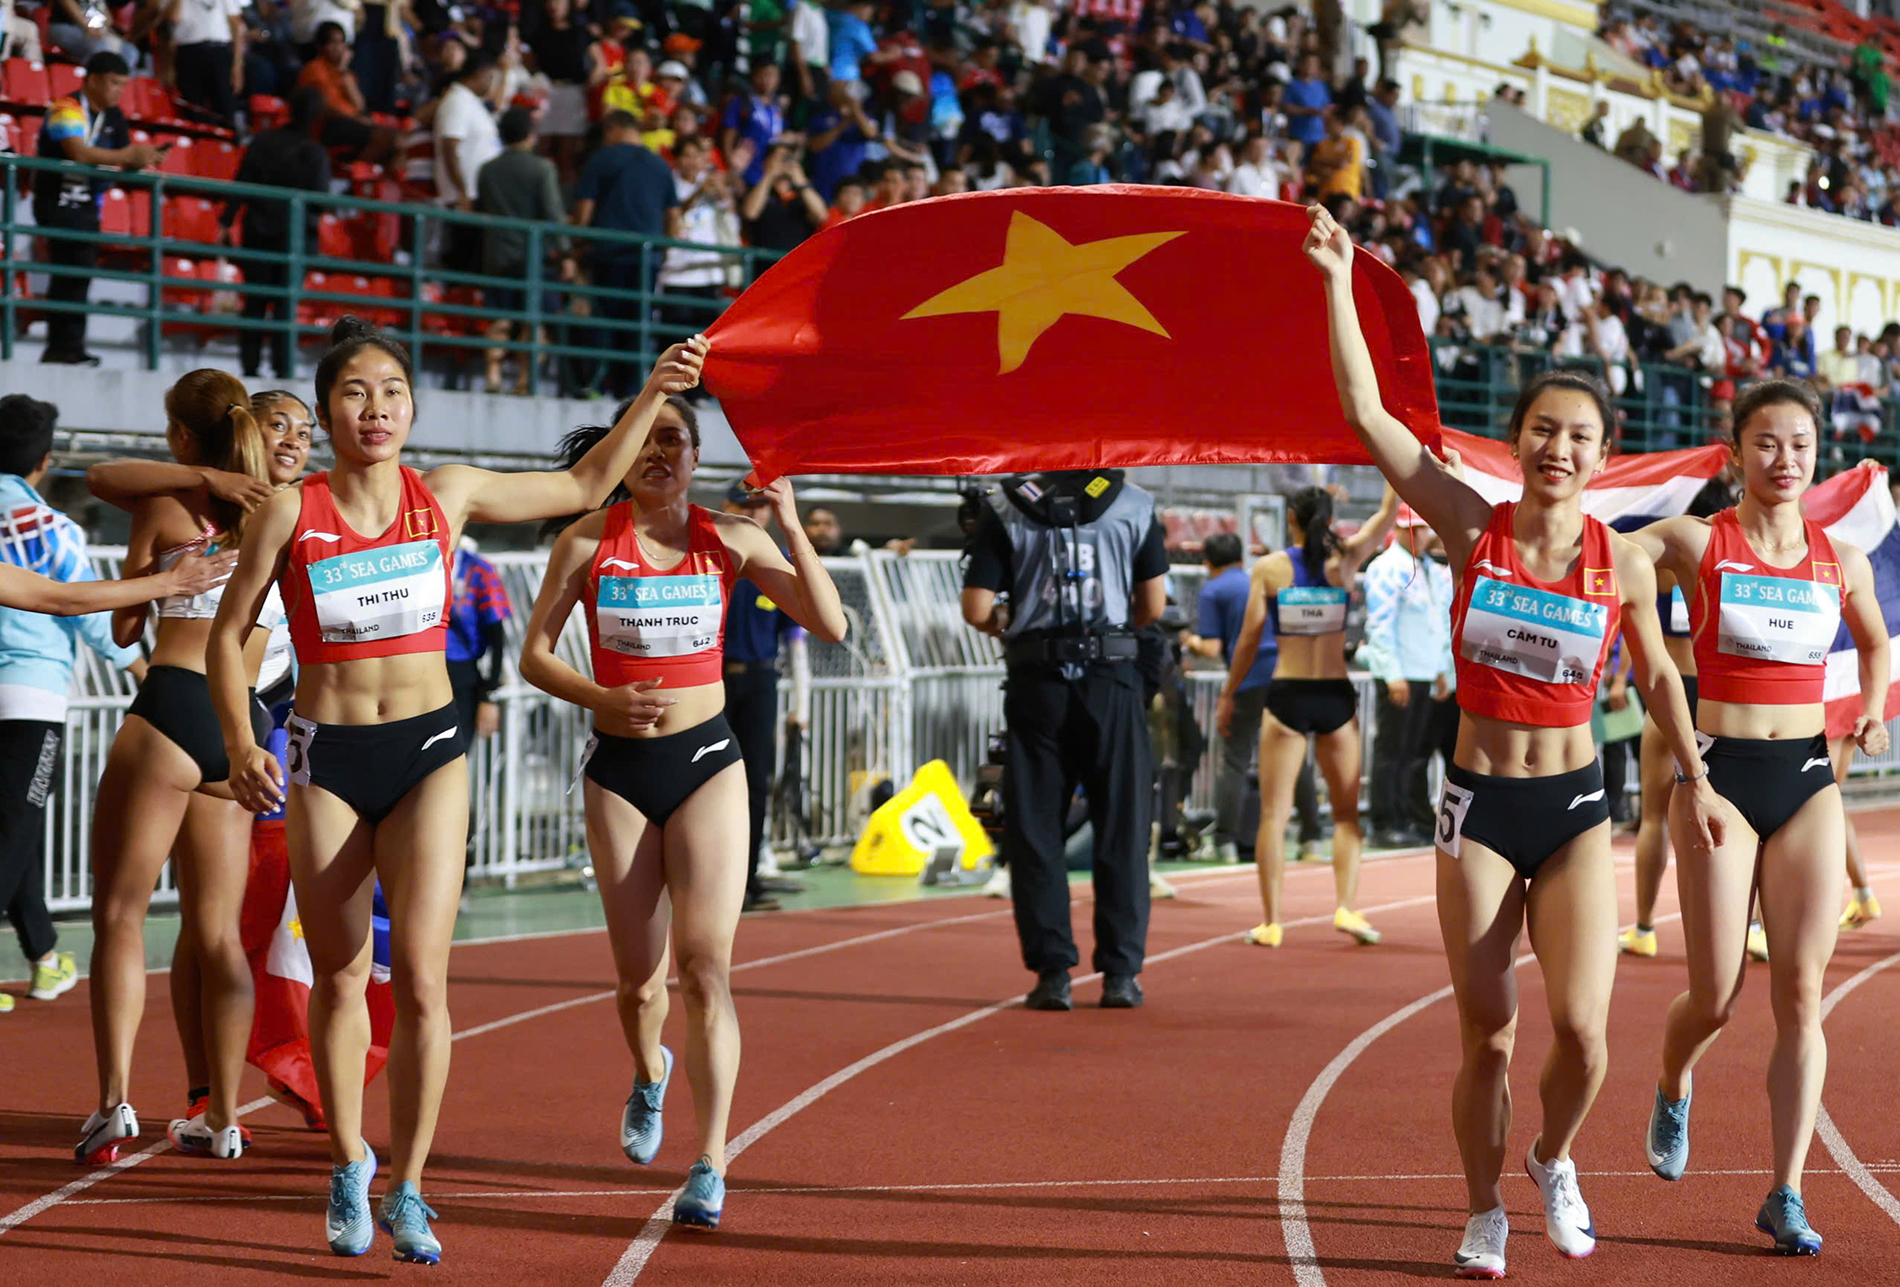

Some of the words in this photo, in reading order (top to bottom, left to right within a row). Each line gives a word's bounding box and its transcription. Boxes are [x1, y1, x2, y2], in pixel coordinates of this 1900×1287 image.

[323, 562, 348, 584] 33rd
[349, 561, 377, 579] SEA
[379, 551, 429, 572] GAMES
[357, 593, 379, 607] THI
[382, 588, 409, 602] THU
[611, 583, 634, 601] 33rd
[635, 586, 659, 601] SEA
[661, 584, 707, 600] GAMES
[1735, 581, 1758, 598] 33rd
[1759, 586, 1783, 602] SEA
[1787, 588, 1818, 605] GAM
[422, 612, 437, 623] 635
[1511, 595, 1539, 616] SEA
[1543, 603, 1592, 628] GAMES
[619, 617, 662, 628] THANH
[666, 616, 698, 627] TRUC
[1769, 618, 1794, 630] HUE
[341, 624, 379, 636] THAILAND
[616, 640, 651, 651] THAILAND
[692, 637, 711, 648] 642
[1507, 629, 1536, 645] CAM
[1540, 637, 1558, 649] TU
[1735, 642, 1772, 653] THAILAND
[1480, 650, 1518, 665] THAILAND
[1562, 669, 1583, 680] 645
[1439, 790, 1461, 843] 5
[911, 808, 946, 845] 2
